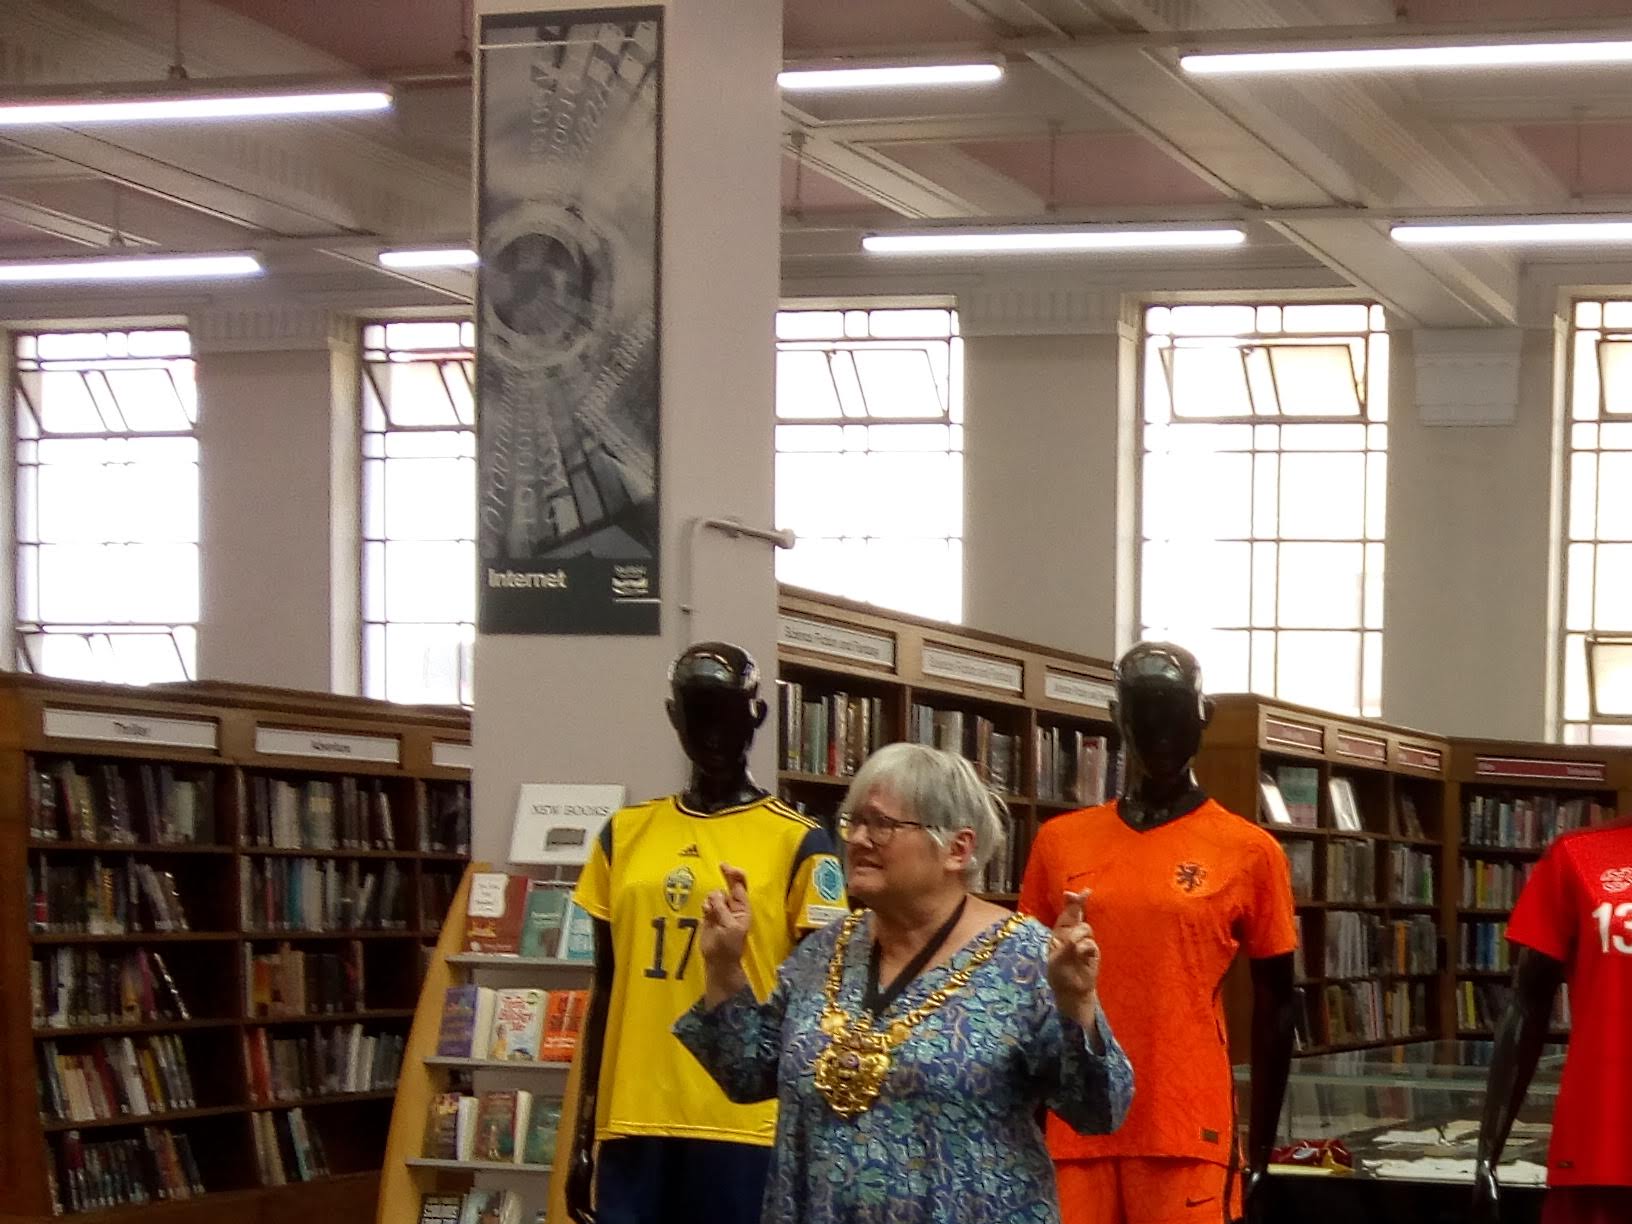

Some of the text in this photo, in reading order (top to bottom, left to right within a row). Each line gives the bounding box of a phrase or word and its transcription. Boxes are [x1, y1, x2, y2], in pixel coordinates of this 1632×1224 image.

[488, 568, 567, 589] Internet
[564, 804, 609, 817] BOOKS
[644, 916, 699, 980] 17
